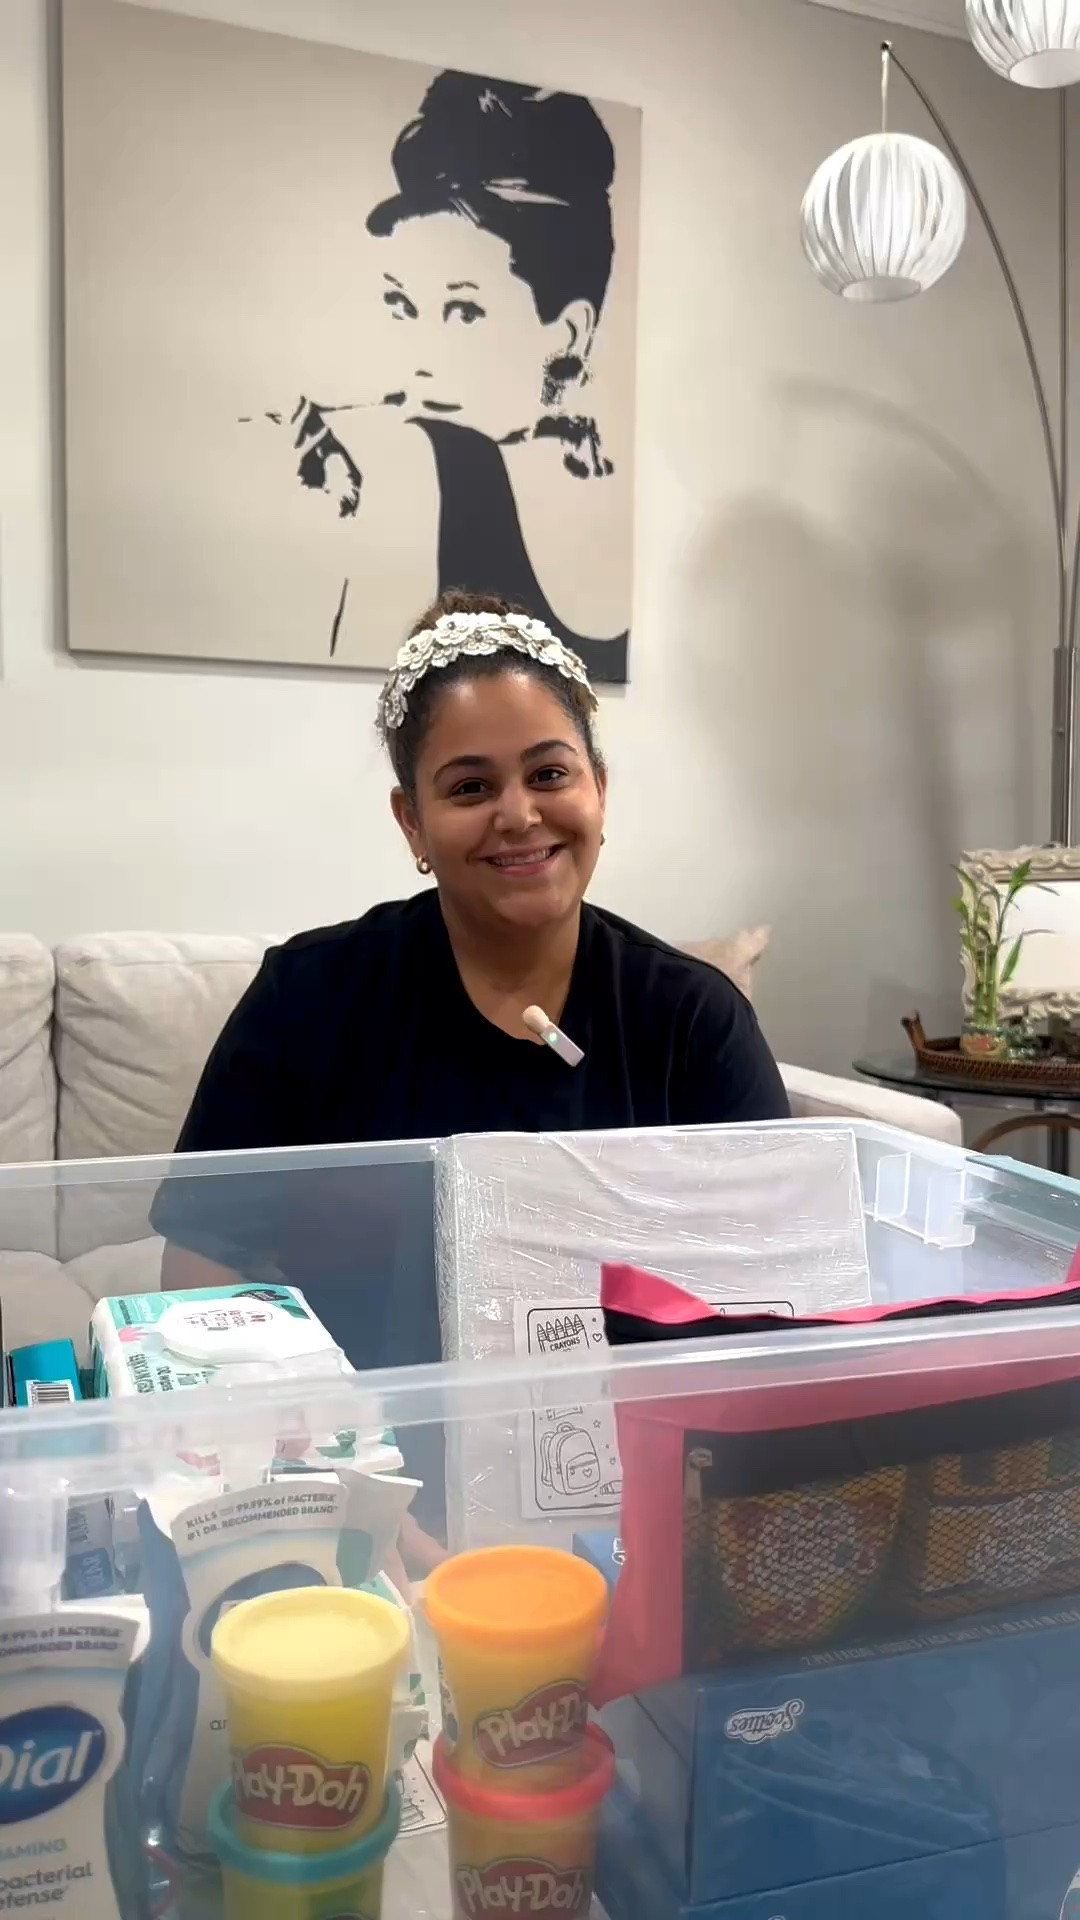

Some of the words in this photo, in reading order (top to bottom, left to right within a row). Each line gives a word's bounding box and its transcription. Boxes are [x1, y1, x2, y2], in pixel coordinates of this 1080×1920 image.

[550, 1337, 581, 1351] CRAYONS
[186, 1511, 218, 1529] KILLS
[222, 1506, 299, 1529] RECOMMENDED
[477, 1691, 582, 1757] Play-D
[726, 1699, 804, 1739] Scotties
[0, 1838, 67, 1862] AMING
[456, 1867, 584, 1913] Play-Doh
